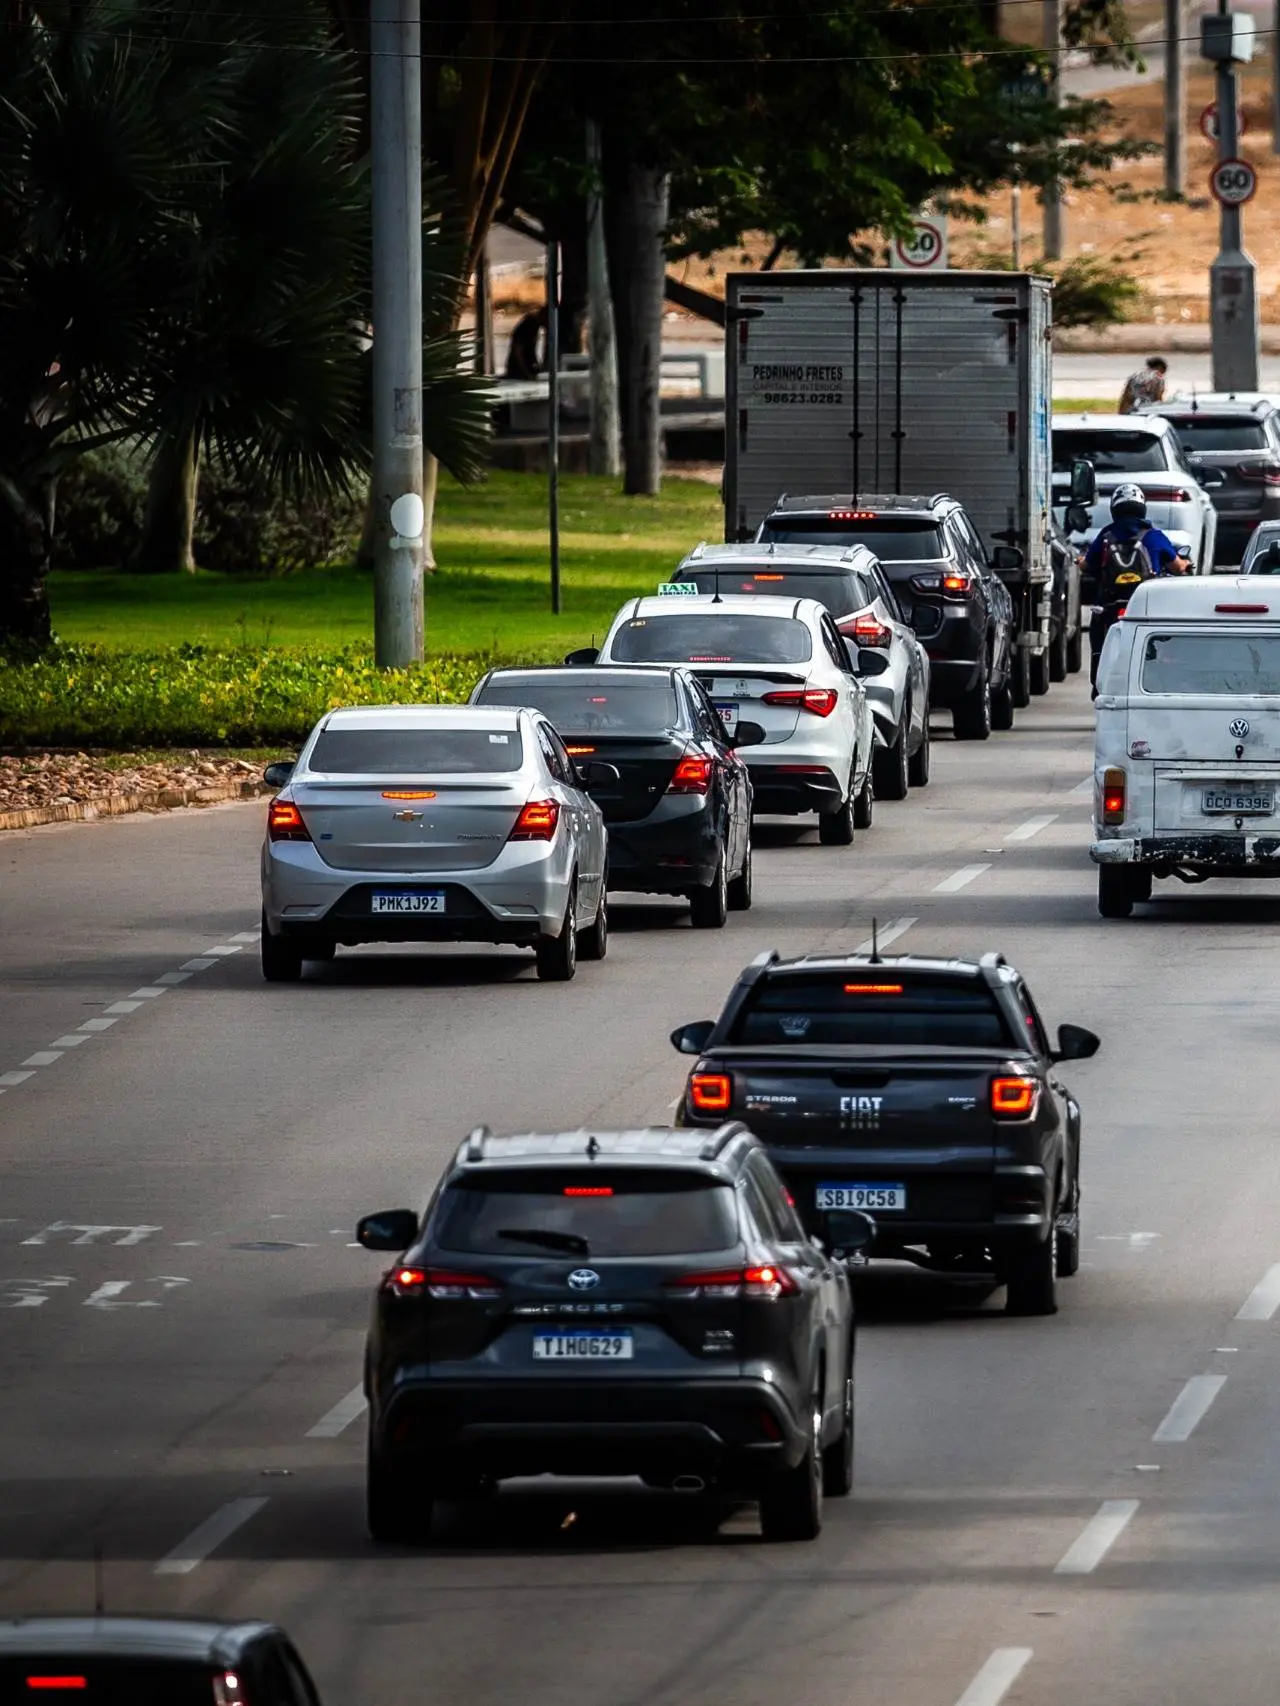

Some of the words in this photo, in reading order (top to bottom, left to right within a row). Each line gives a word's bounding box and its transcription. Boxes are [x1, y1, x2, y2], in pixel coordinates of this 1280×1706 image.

[1219, 170, 1248, 190] 60
[753, 366, 804, 380] PEDRINHO
[806, 366, 844, 380] FRETES
[661, 584, 696, 592] TAXI
[379, 897, 438, 911] PMK1J92
[745, 1095, 797, 1103] STRADA
[840, 1096, 882, 1112] FIAT
[825, 1190, 897, 1206] SBI9C58
